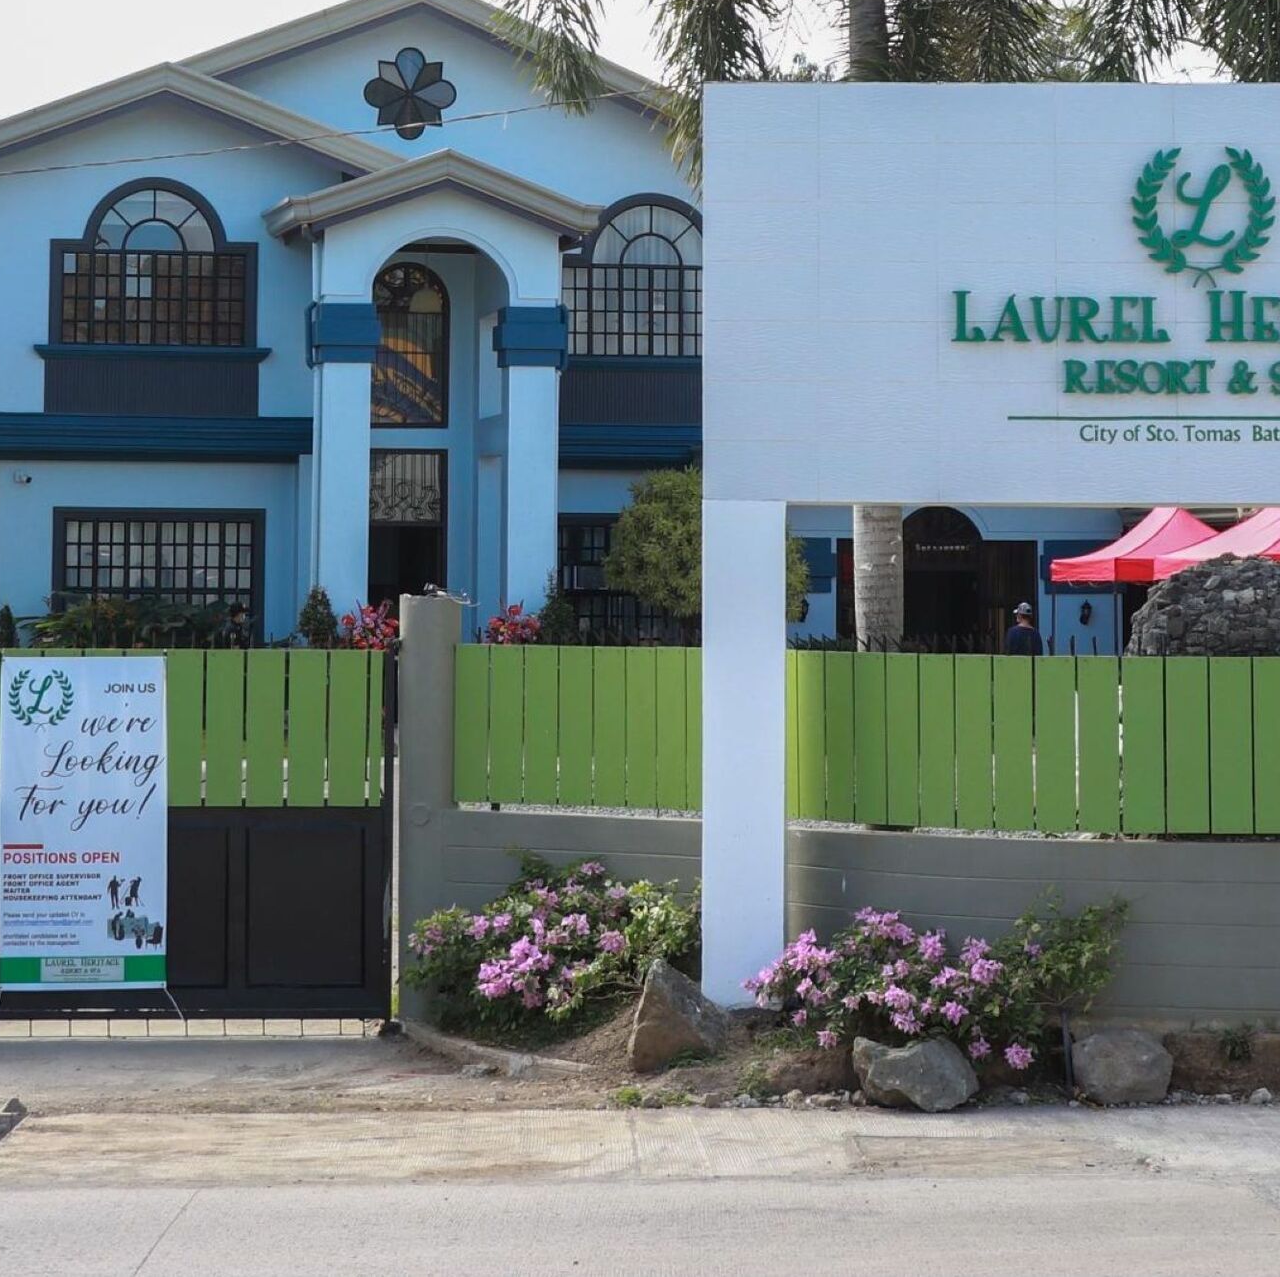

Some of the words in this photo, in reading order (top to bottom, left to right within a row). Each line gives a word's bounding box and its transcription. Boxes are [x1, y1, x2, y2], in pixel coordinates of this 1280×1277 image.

[951, 290, 1171, 343] LAUREL
[1063, 359, 1215, 394] RESORT
[1227, 359, 1258, 394] &
[1079, 424, 1117, 445] City
[1123, 424, 1140, 442] of
[1146, 424, 1179, 442] Sto.
[1183, 425, 1241, 442] Tomas
[104, 683, 134, 694] JOIN
[137, 683, 156, 693] US
[40, 740, 165, 787] Looking
[14, 784, 68, 821] For
[71, 783, 157, 831] you!
[3, 852, 77, 864] POSITIONS
[81, 852, 120, 863] OPEN
